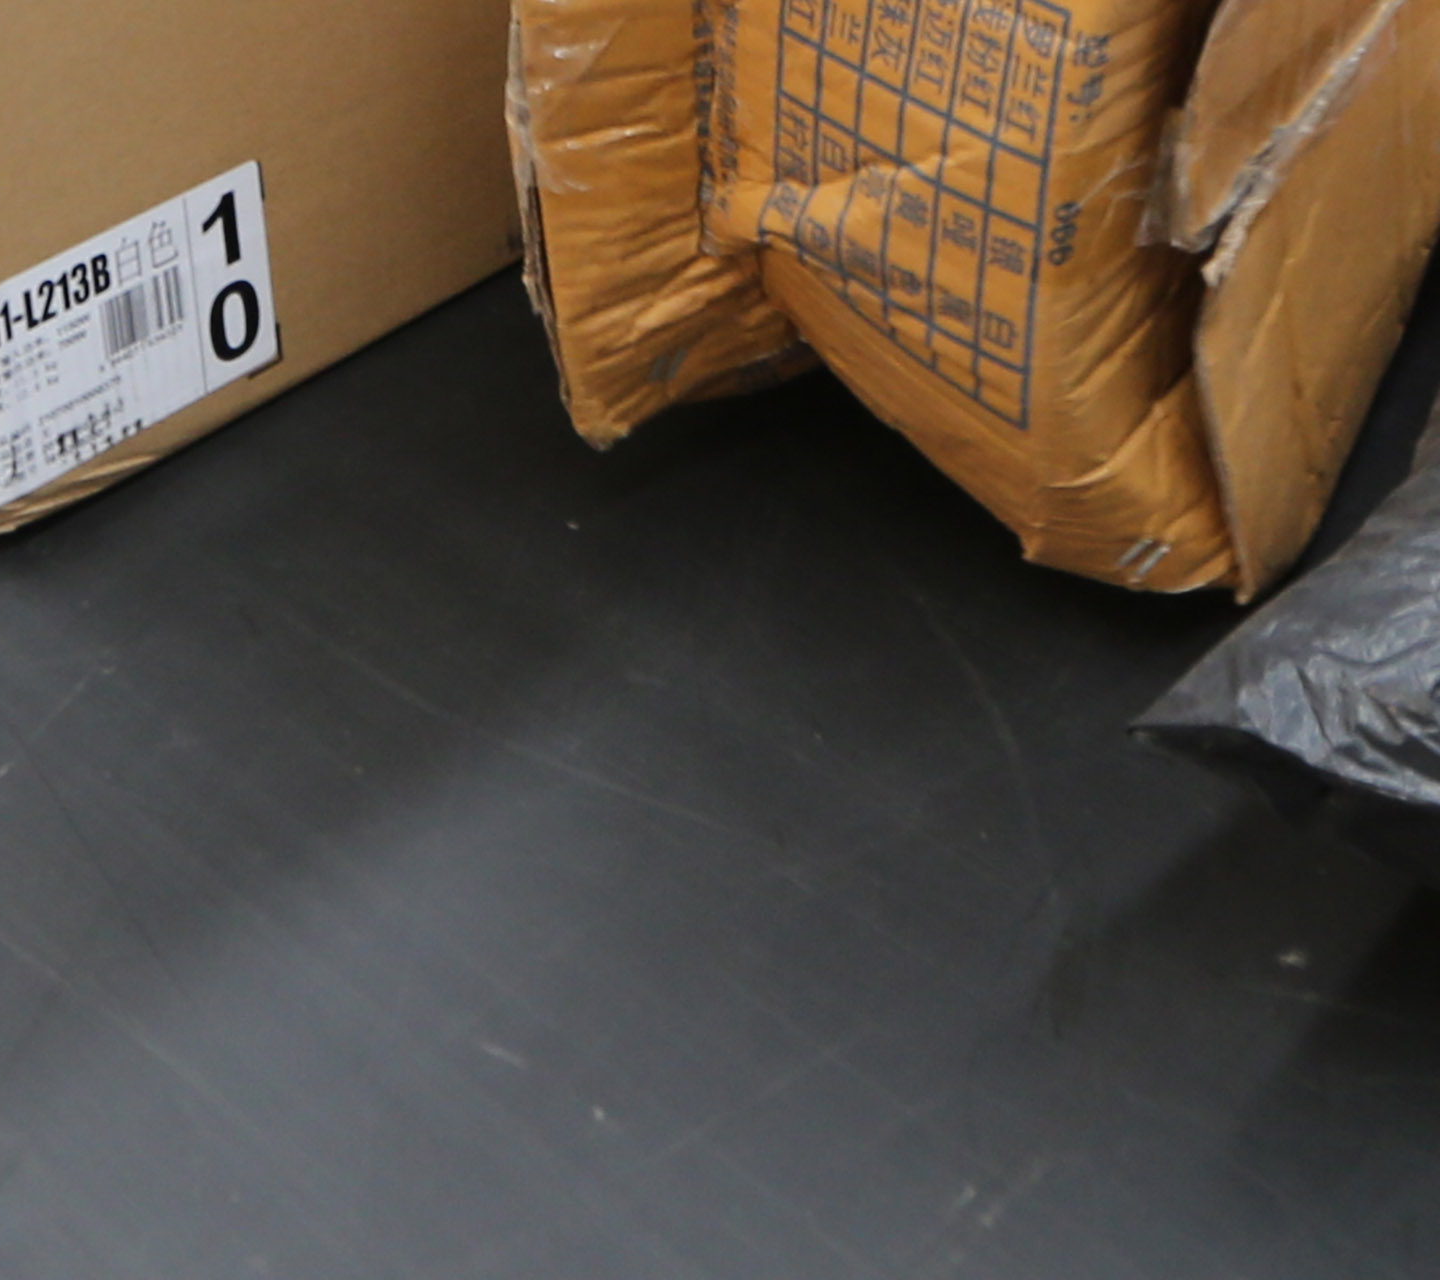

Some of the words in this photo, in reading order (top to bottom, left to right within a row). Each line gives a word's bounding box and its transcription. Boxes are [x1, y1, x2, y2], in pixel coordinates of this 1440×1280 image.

[1005, 9, 1061, 142] 罗兰红
[116, 220, 179, 287] 白色
